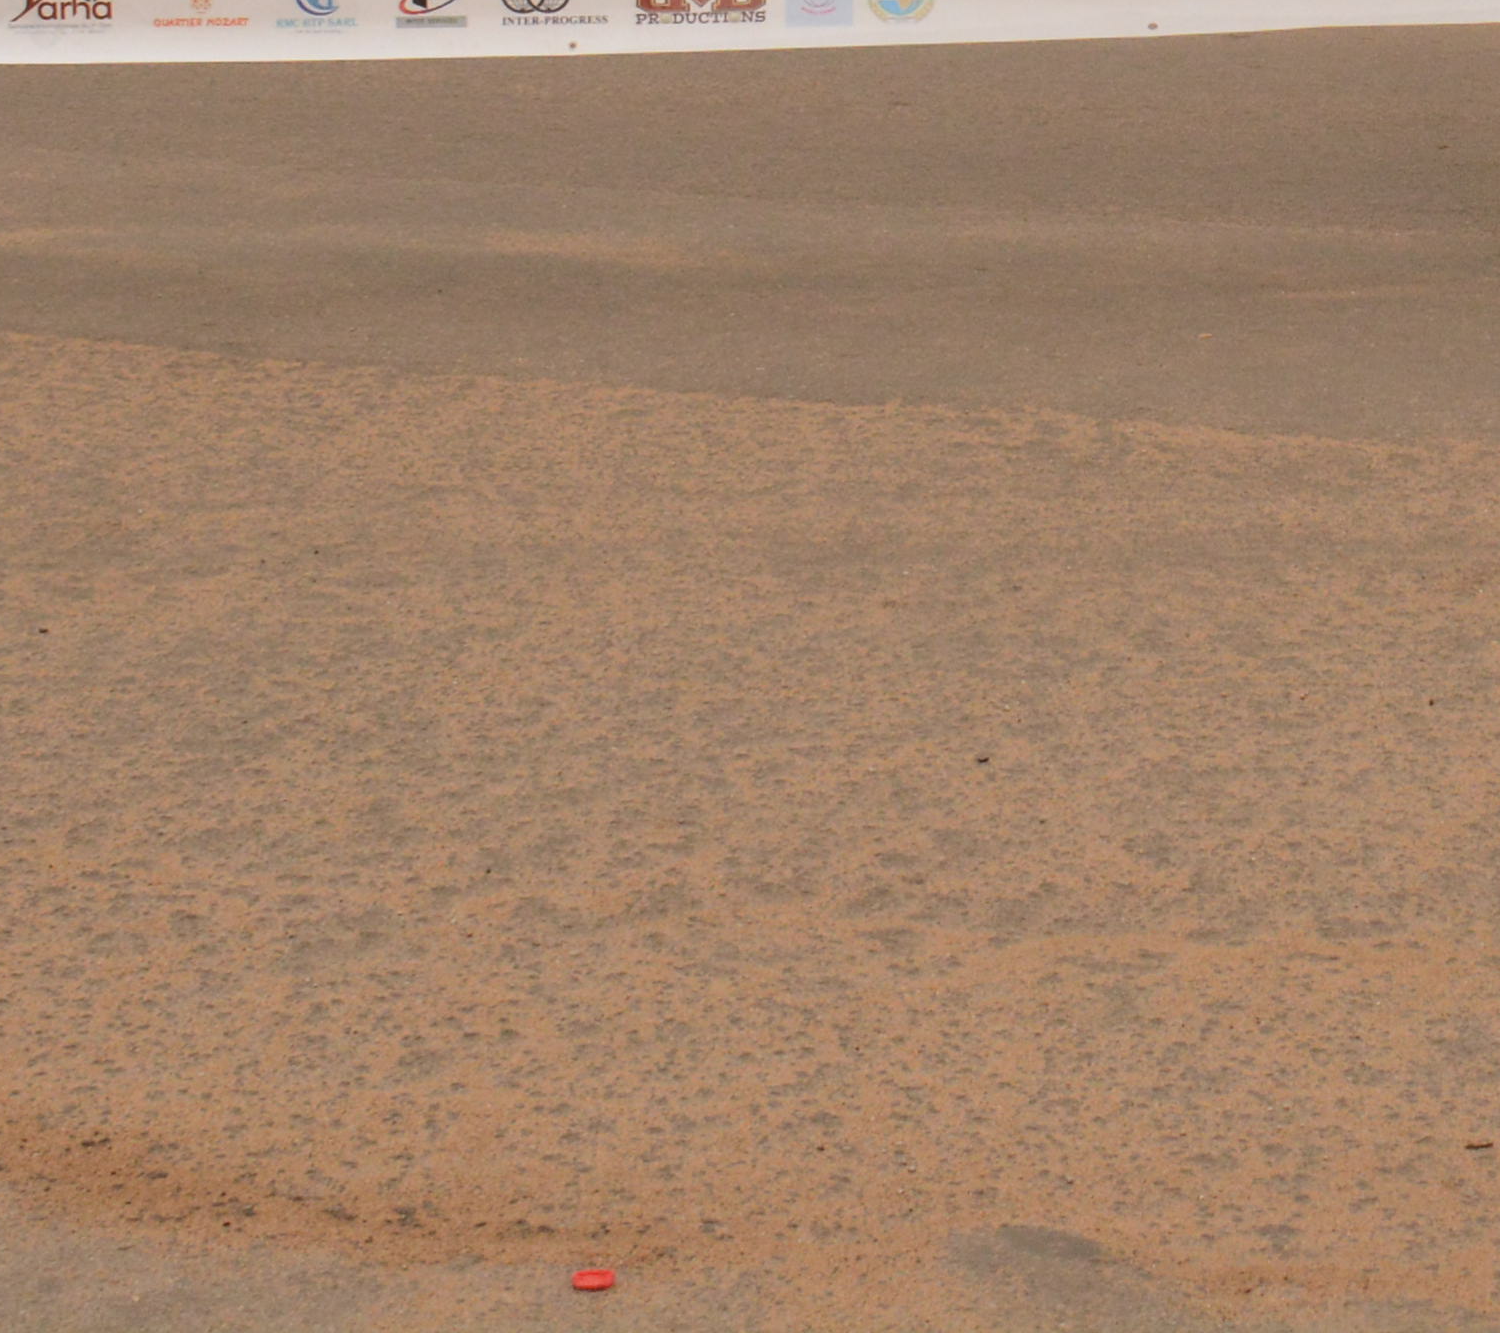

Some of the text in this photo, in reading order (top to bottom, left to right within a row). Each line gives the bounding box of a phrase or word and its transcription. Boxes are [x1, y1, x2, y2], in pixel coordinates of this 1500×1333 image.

[154, 17, 249, 28] QUARTIER MOZART
[501, 15, 609, 27] INTER-PROGRESS
